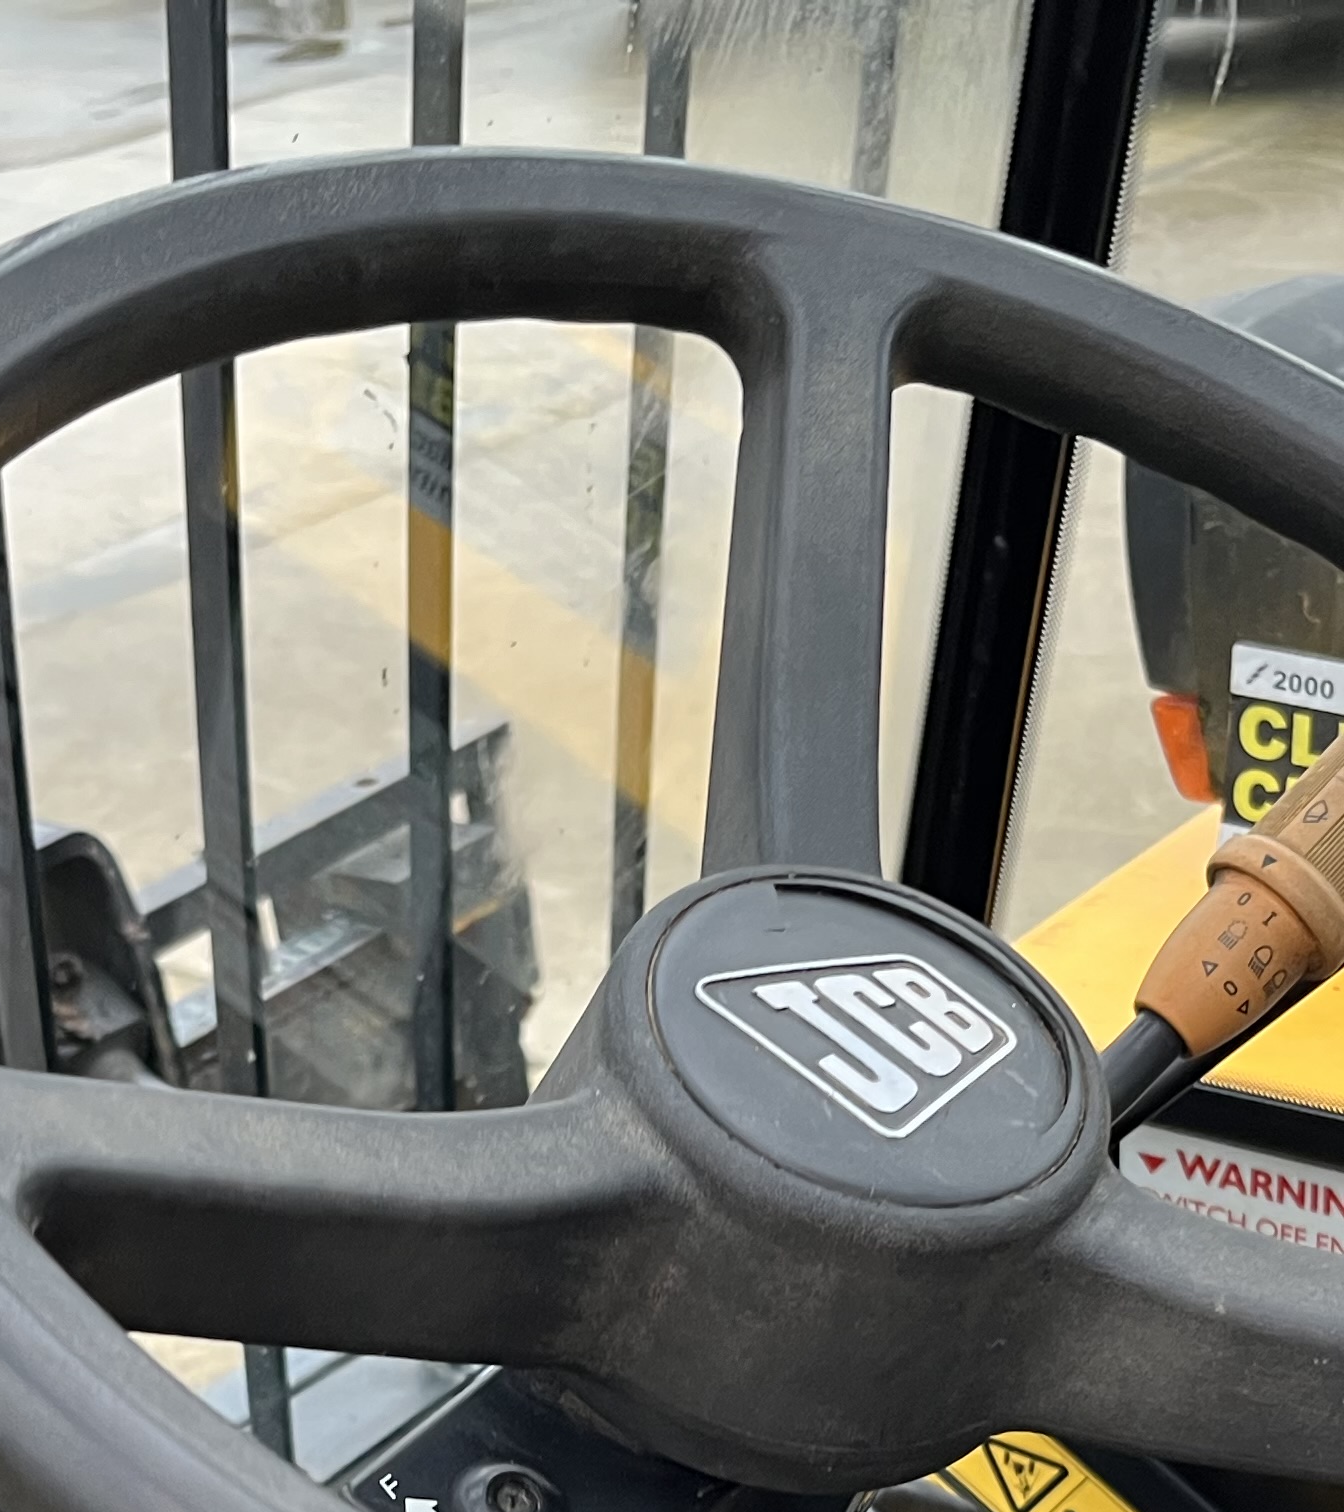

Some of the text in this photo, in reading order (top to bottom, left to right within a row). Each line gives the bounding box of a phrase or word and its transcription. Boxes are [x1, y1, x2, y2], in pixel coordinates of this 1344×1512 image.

[1272, 670, 1334, 700] 2000
[752, 966, 994, 1113] JCB
[379, 1473, 398, 1500] F
